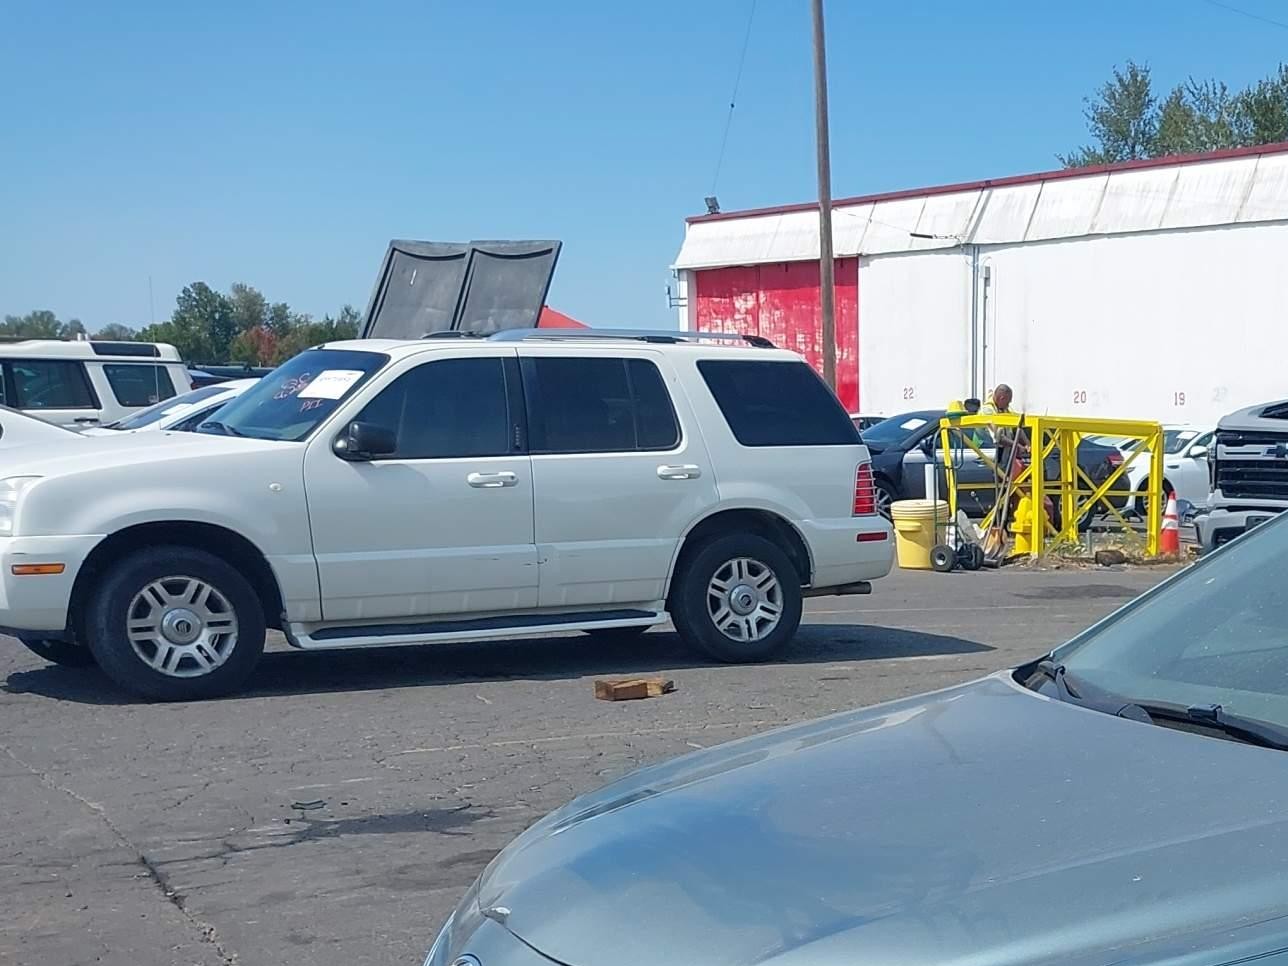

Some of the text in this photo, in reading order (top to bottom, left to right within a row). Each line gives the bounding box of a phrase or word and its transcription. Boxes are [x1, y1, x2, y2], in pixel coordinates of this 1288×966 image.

[903, 387, 914, 400] 22
[1073, 390, 1087, 404] 20
[1174, 391, 1186, 406] 19
